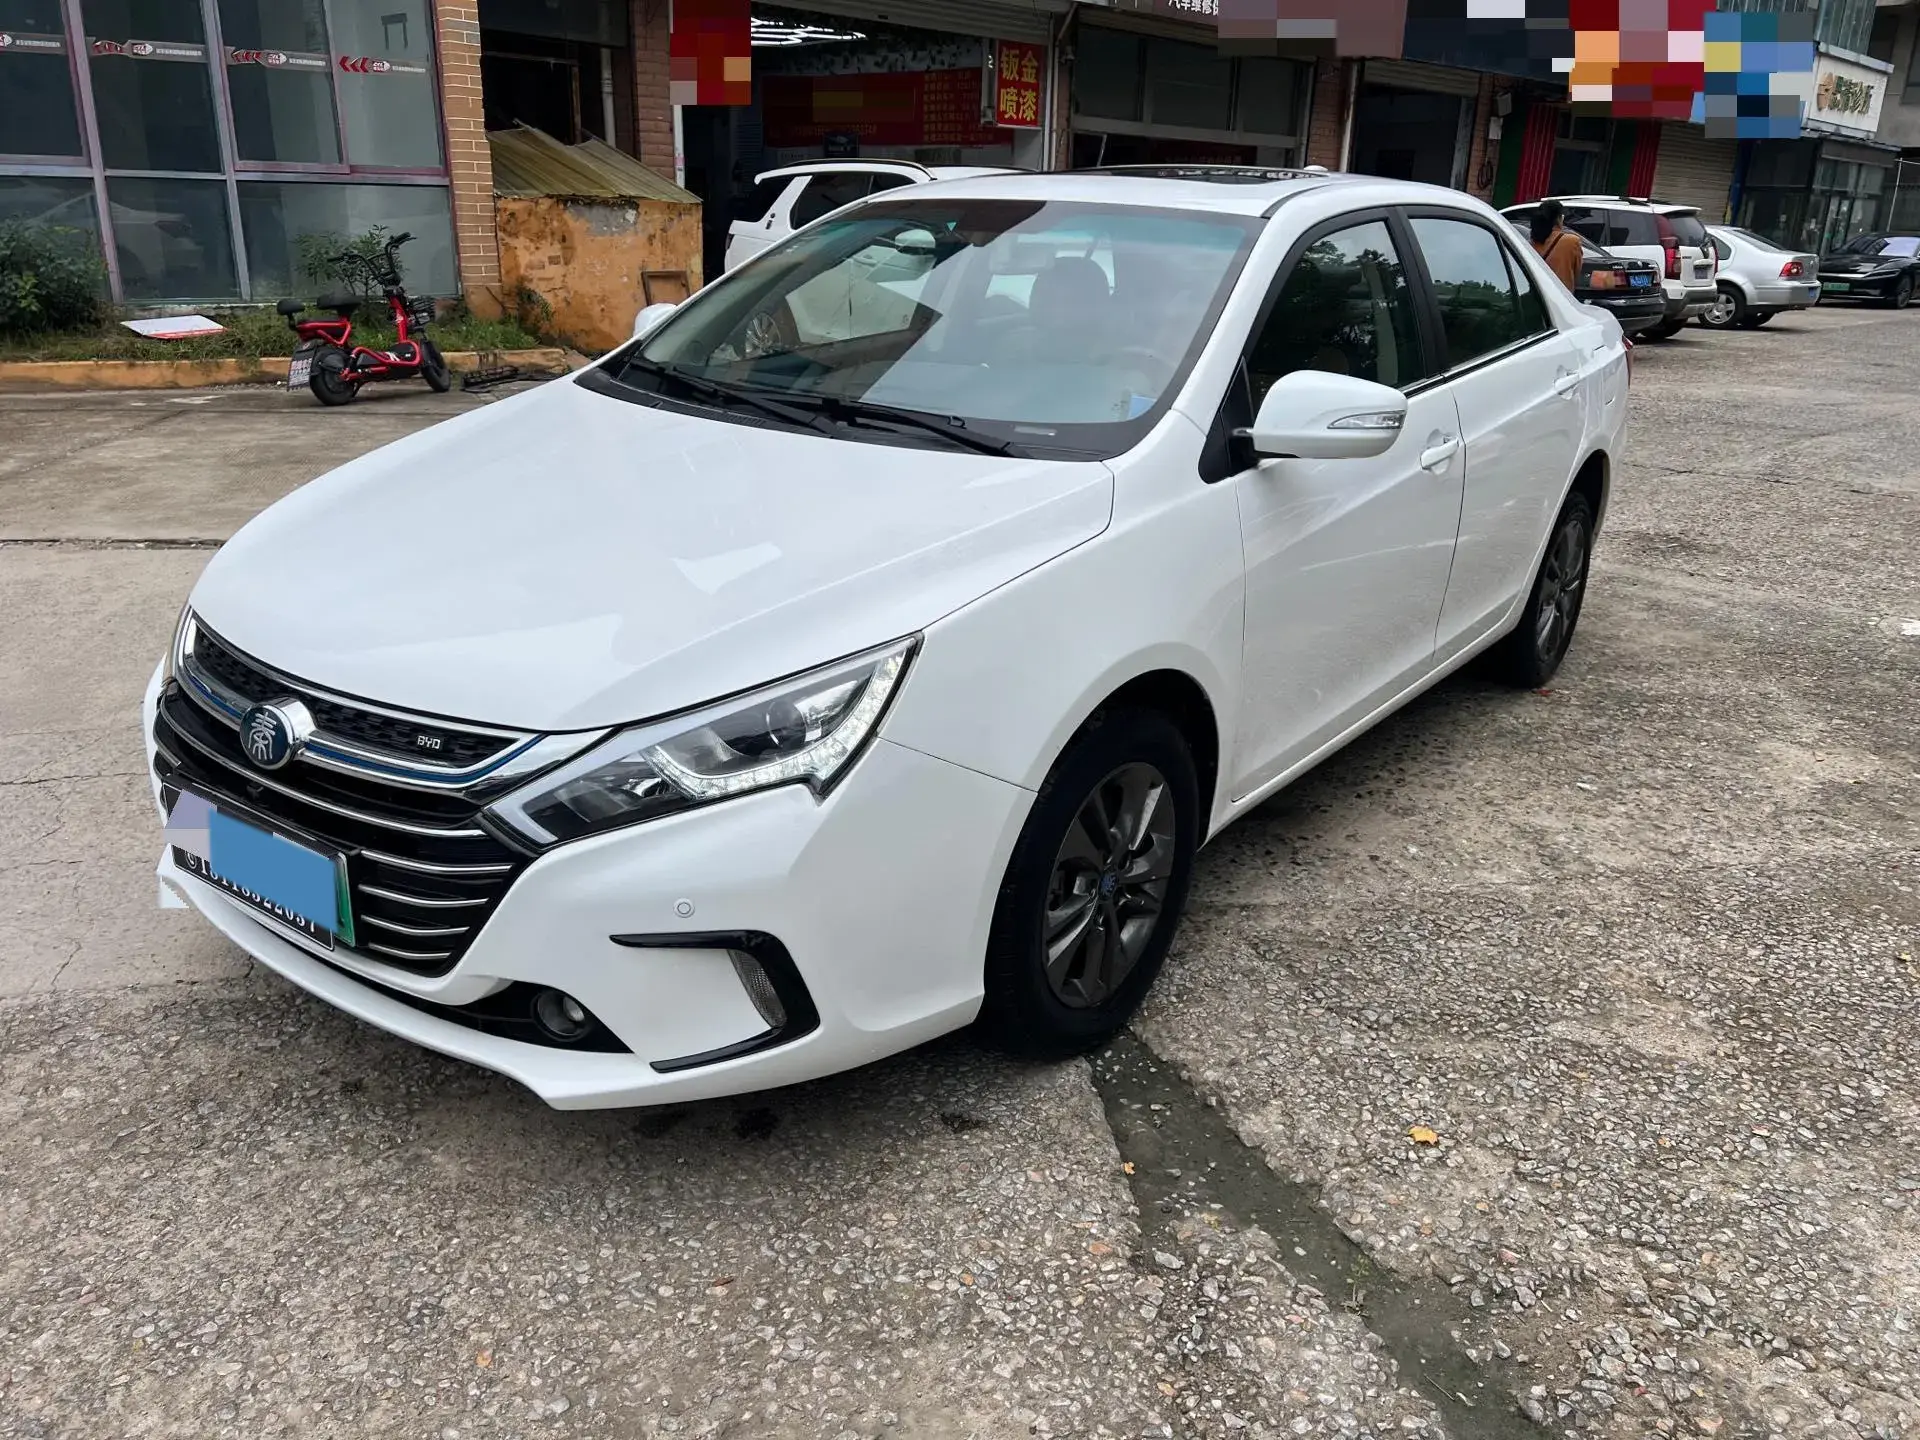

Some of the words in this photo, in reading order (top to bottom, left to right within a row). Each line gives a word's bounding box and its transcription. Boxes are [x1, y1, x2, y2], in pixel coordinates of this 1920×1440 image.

[1000, 46, 1038, 83] 钣金
[1000, 86, 1037, 121] 喷漆
[248, 711, 277, 761] 秦
[417, 735, 441, 750] BYD
